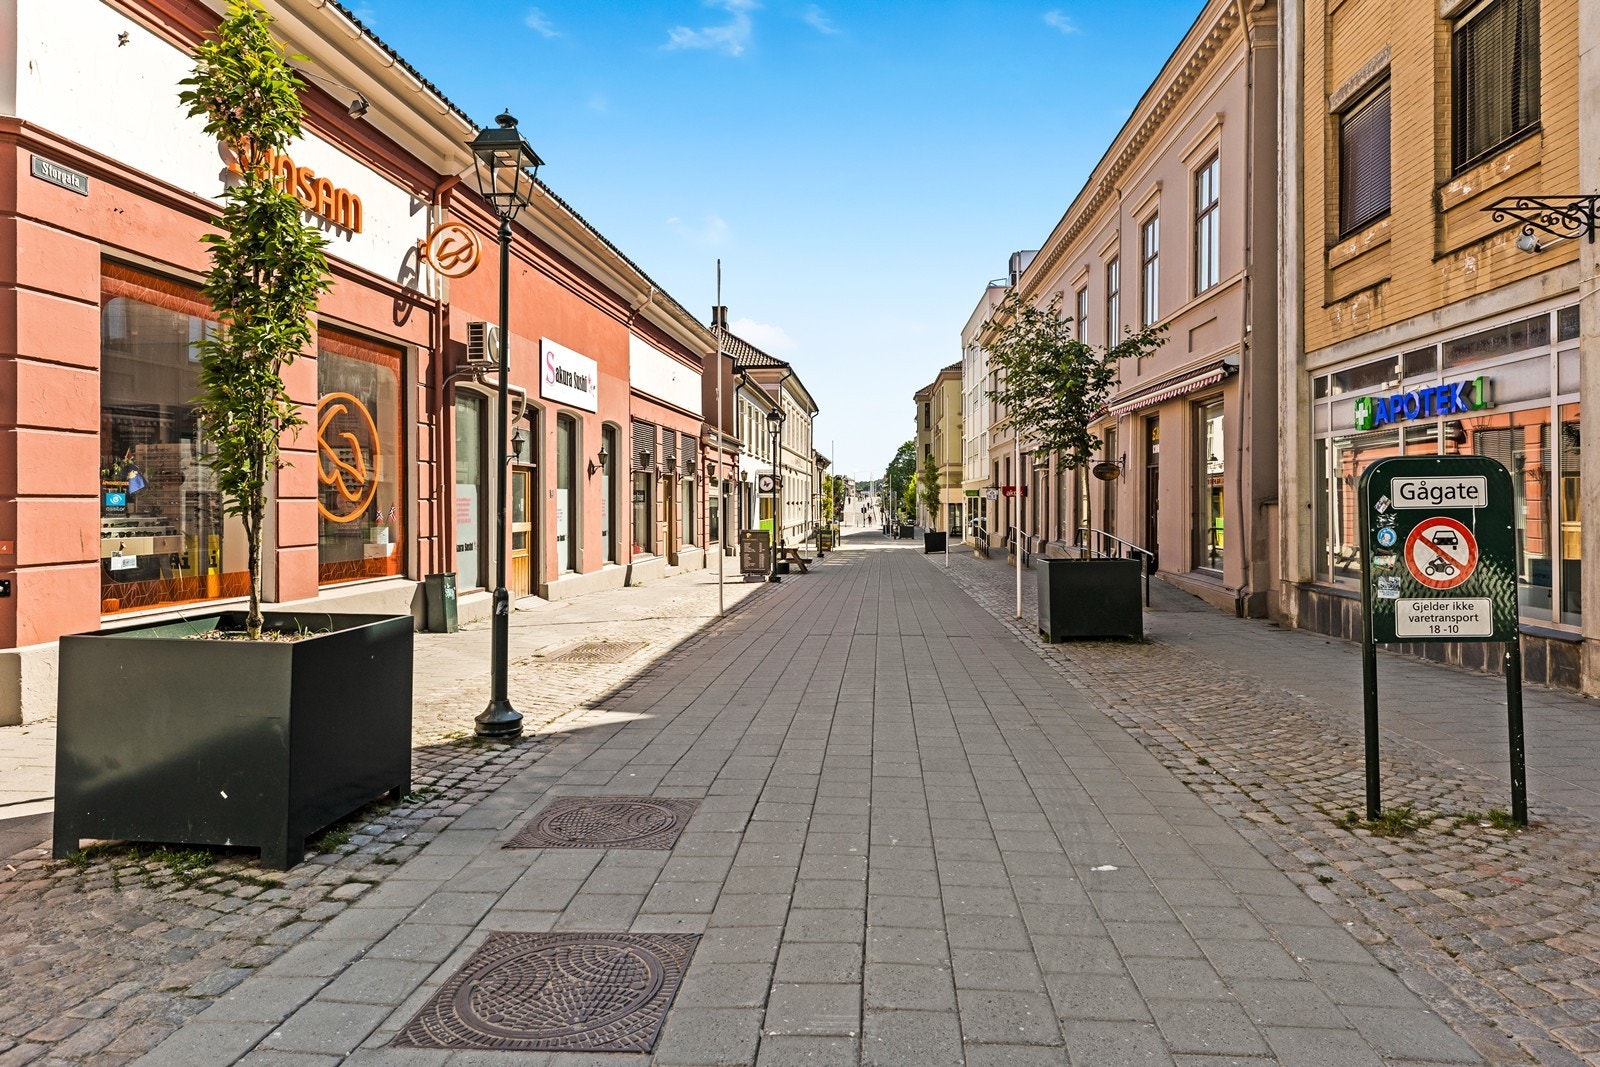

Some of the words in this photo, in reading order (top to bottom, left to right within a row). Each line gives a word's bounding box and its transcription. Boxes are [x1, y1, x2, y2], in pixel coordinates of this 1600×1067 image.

[42, 162, 80, 188] Storgata
[546, 351, 573, 387] Sakura
[574, 371, 588, 393] Sushi
[1374, 381, 1470, 426] APOTEK
[1399, 481, 1479, 505] Gågate
[1408, 613, 1480, 625] varetransport
[1412, 601, 1450, 613] Gjelder
[1452, 601, 1475, 611] ikke
[1429, 624, 1442, 634] 18
[1443, 624, 1460, 634] -10
[424, 1015, 457, 1044] ULEFOS
